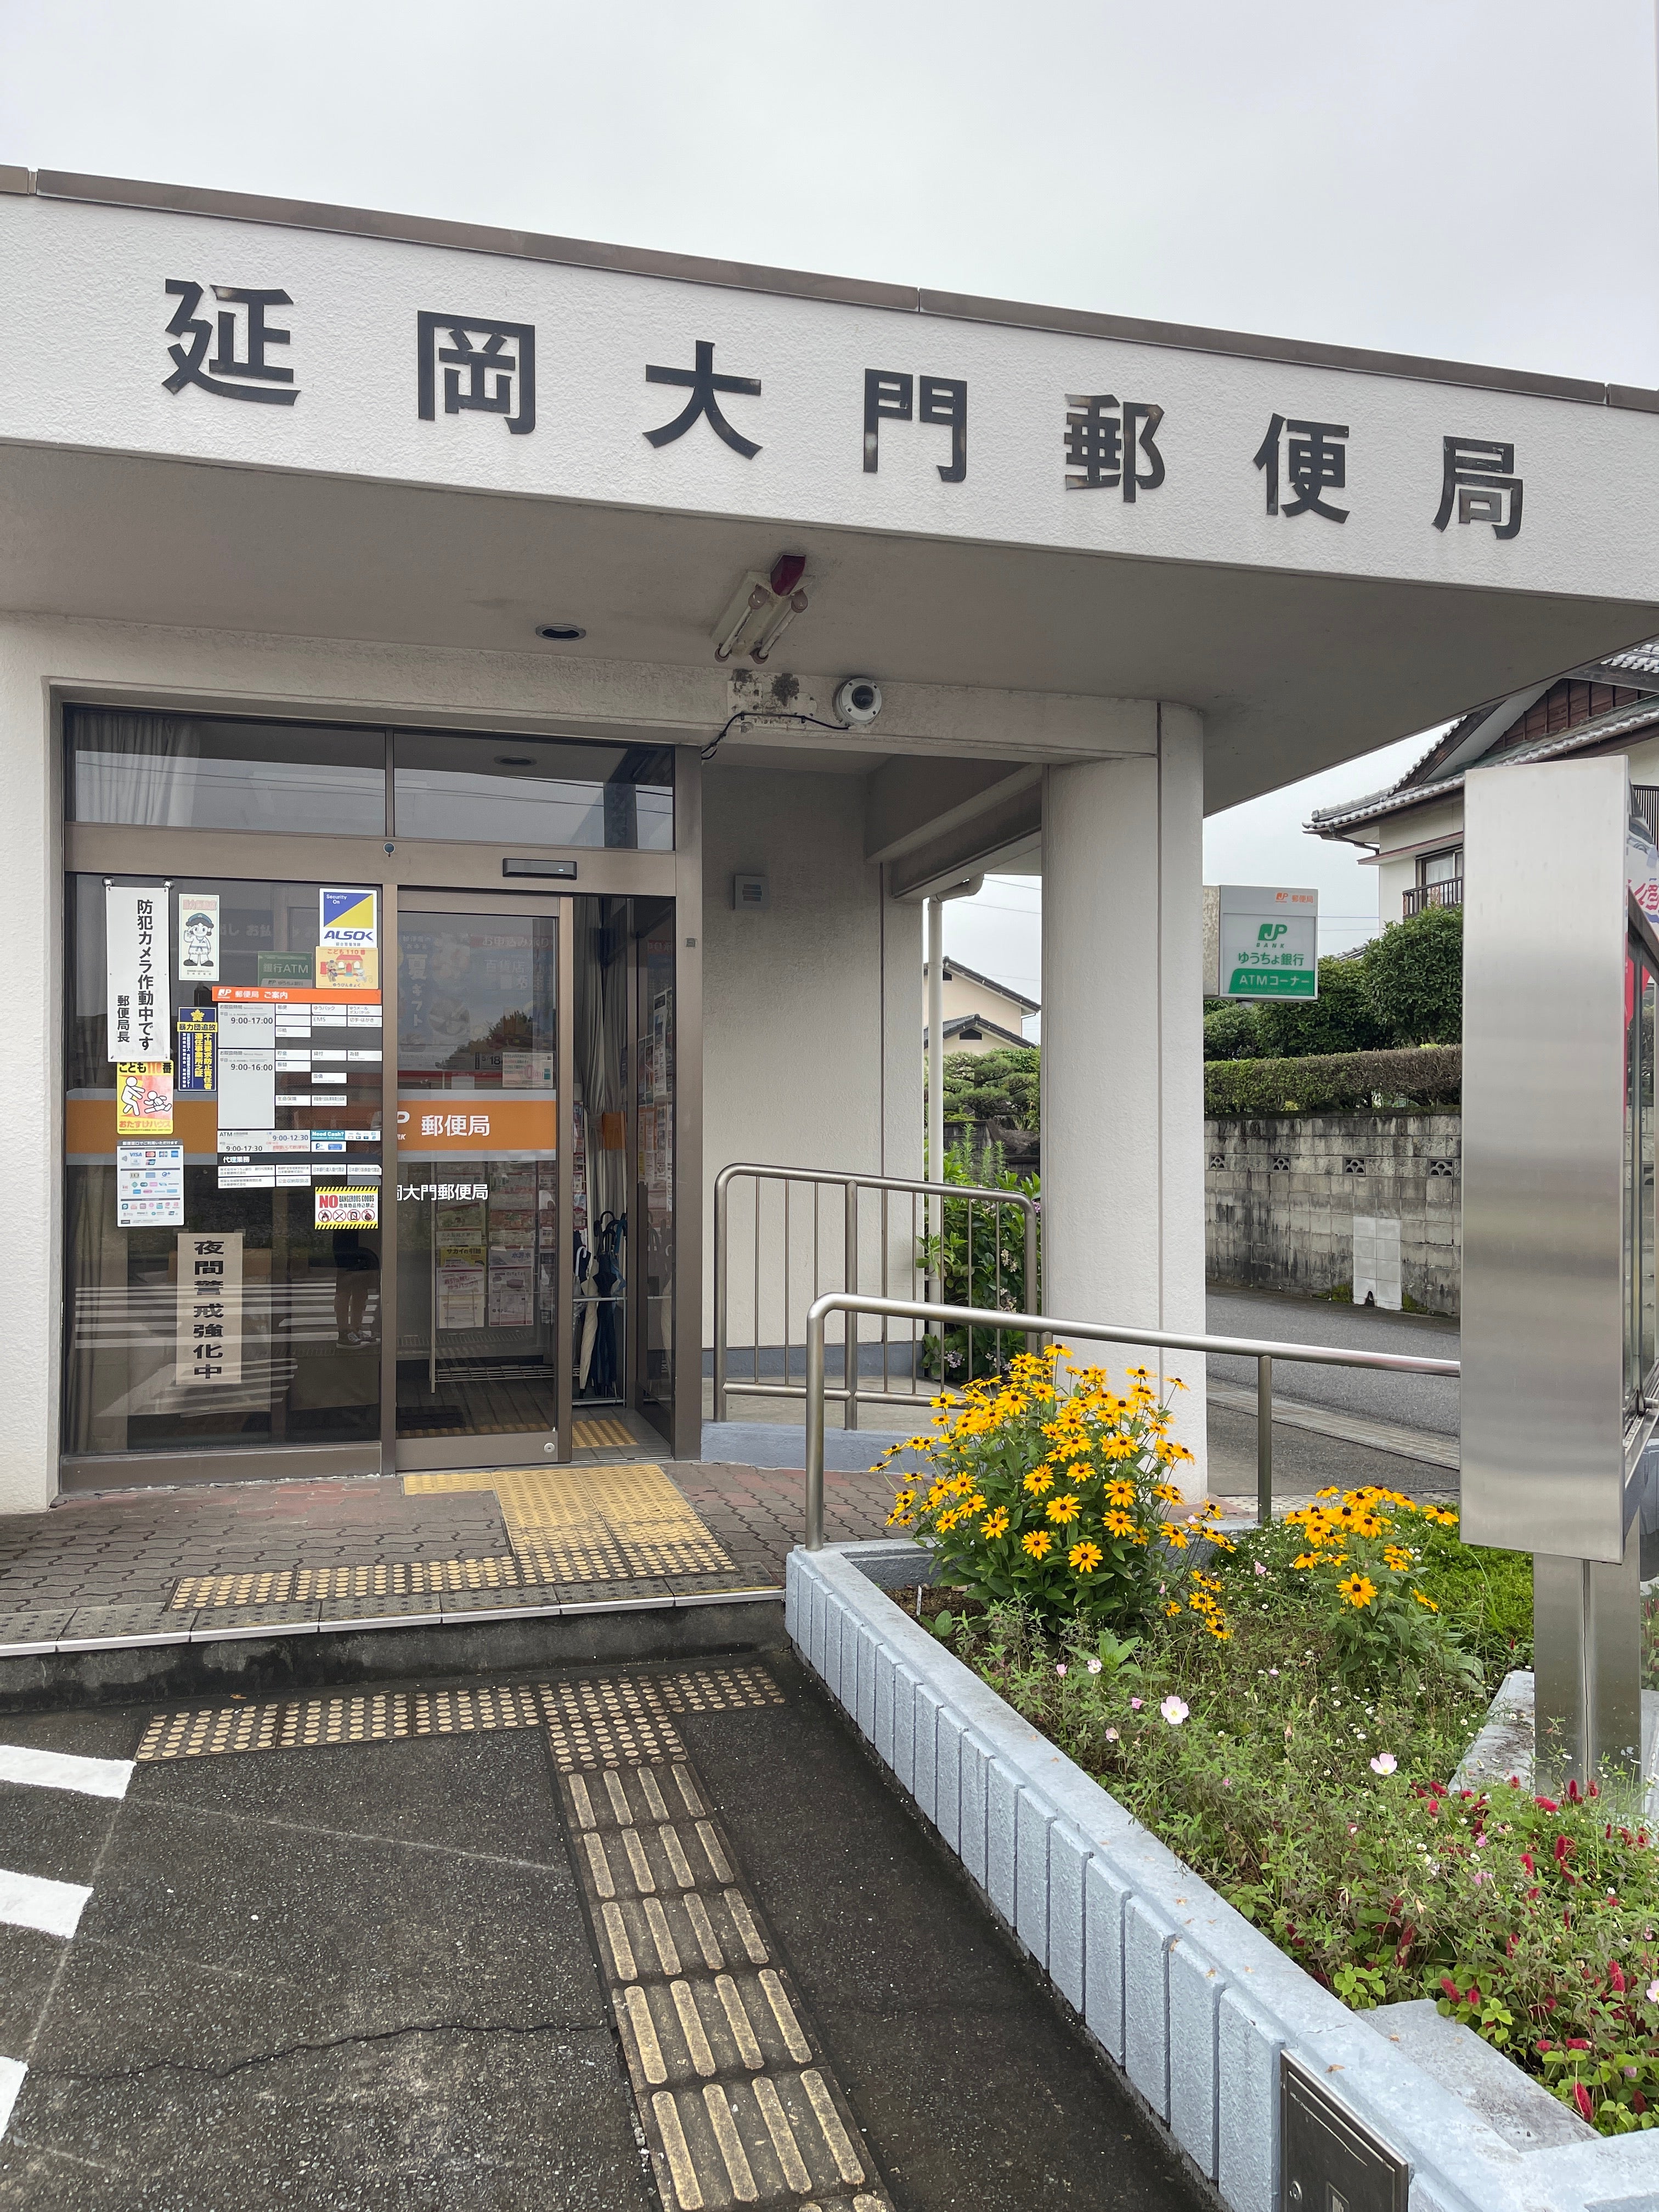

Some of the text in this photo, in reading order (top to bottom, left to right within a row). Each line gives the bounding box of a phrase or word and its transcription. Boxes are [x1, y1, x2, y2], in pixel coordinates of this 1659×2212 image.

[161, 278, 1524, 541] 延岡大門郵便局
[324, 930, 374, 941] ALSOK
[1238, 952, 1305, 966] ゆうちょ銀行
[137, 899, 154, 1051] 防犯カメラ作動中です
[263, 963, 308, 974] 銀行ATM
[1239, 975, 1310, 986] ATMコーナー
[117, 995, 130, 1043] 郵便局長
[421, 1114, 490, 1137] 郵便局
[319, 1195, 338, 1209] NO
[193, 1240, 225, 1379] 夜間警戒強化中
